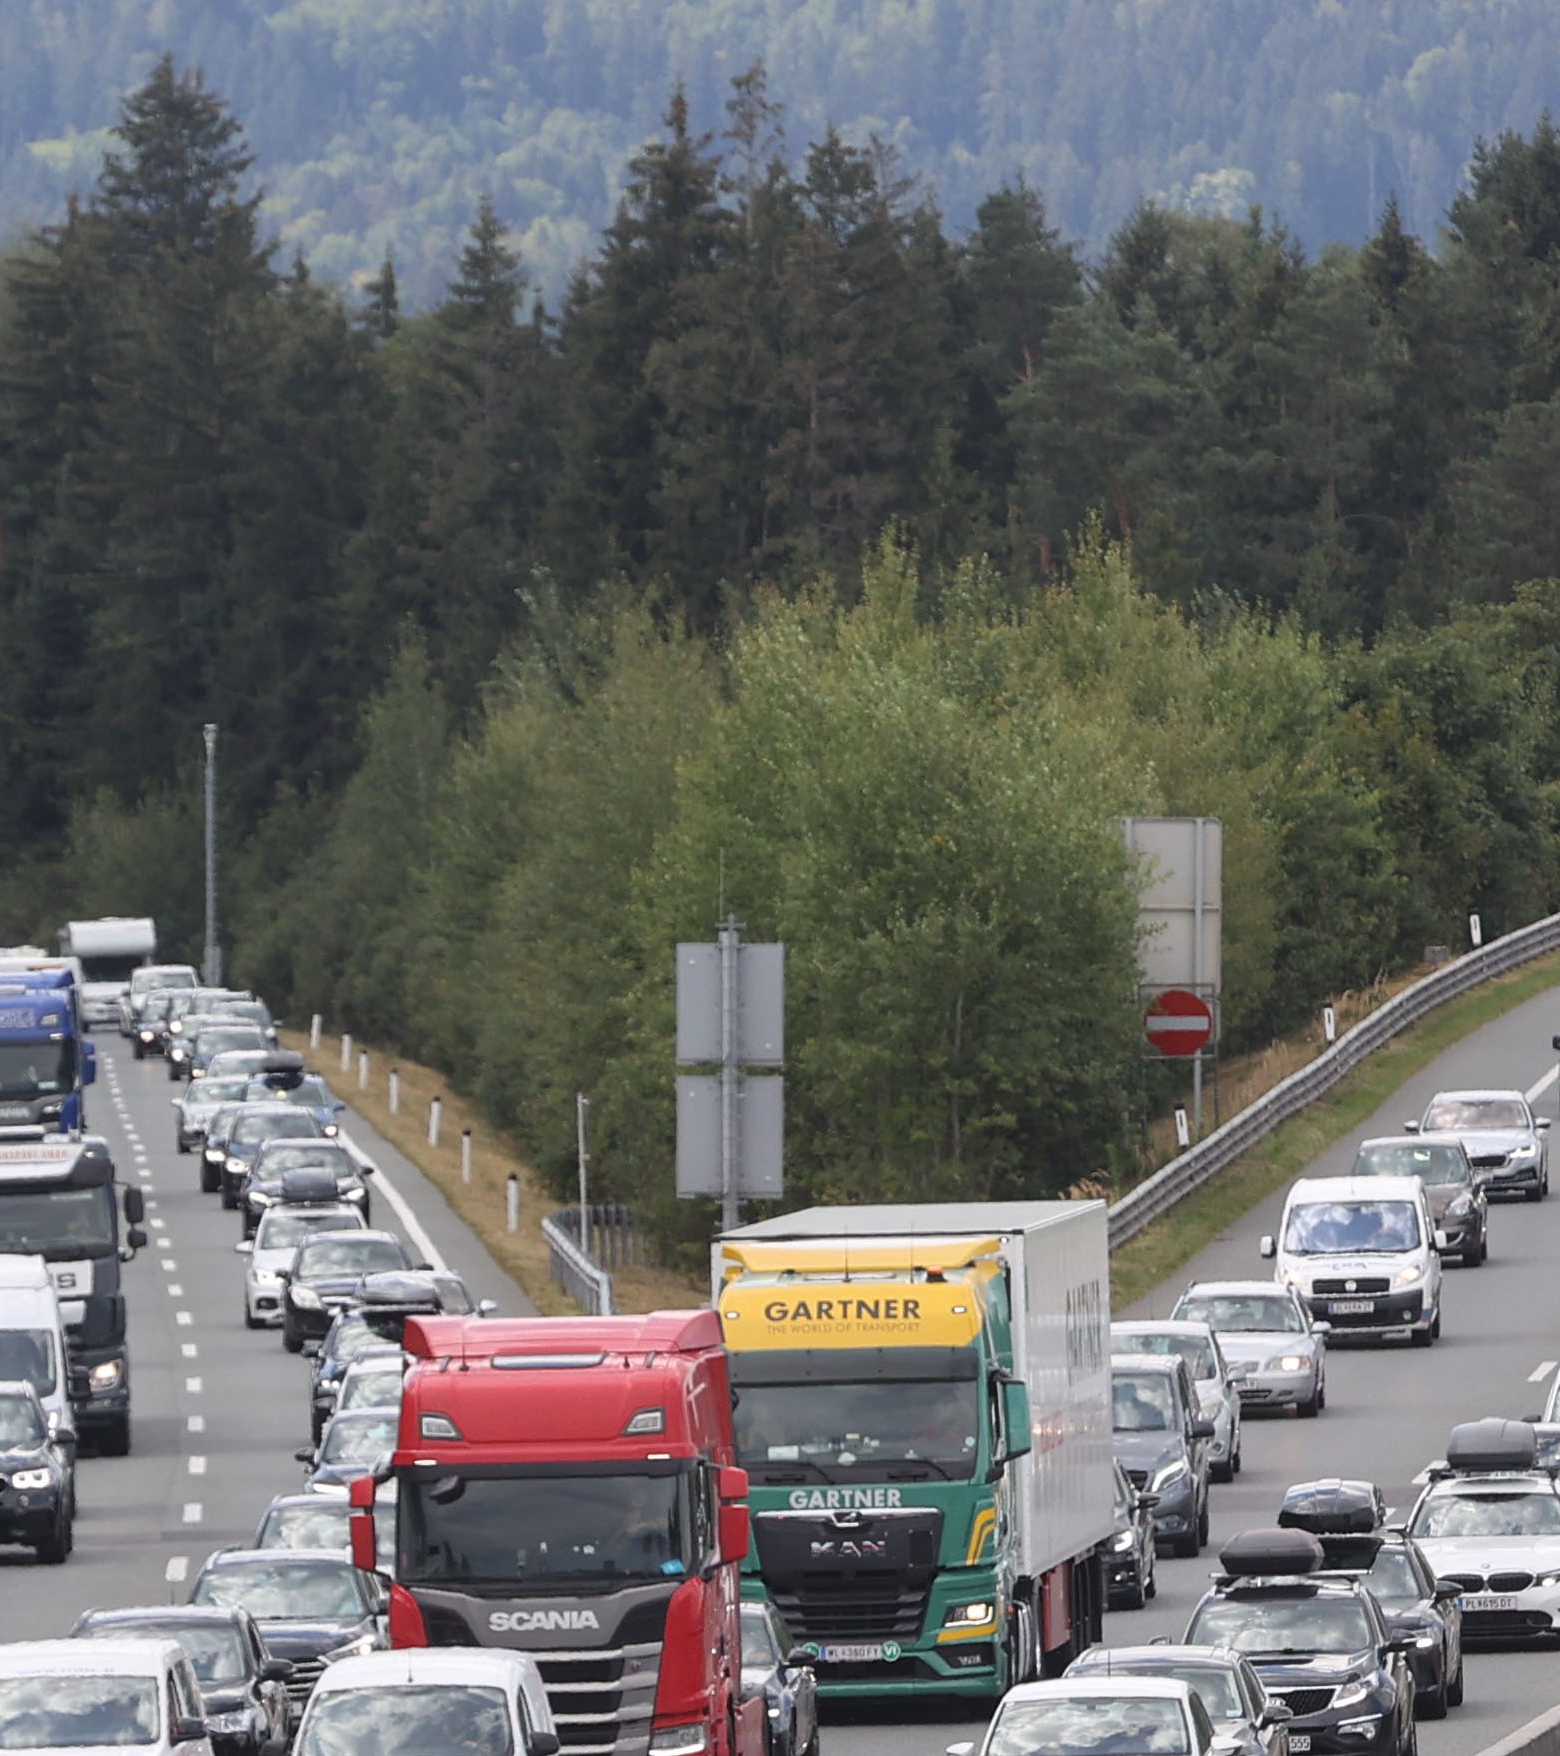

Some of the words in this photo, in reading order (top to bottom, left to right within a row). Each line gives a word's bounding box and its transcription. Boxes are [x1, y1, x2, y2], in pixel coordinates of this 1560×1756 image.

[765, 1300, 920, 1321] GARTNER
[768, 1324, 786, 1334] THE
[791, 1323, 832, 1333] WORLD
[836, 1323, 851, 1332] OF
[856, 1322, 920, 1332] TRANSPORT
[789, 1489, 901, 1509] GARTNER
[488, 1610, 599, 1631] SCANIA
